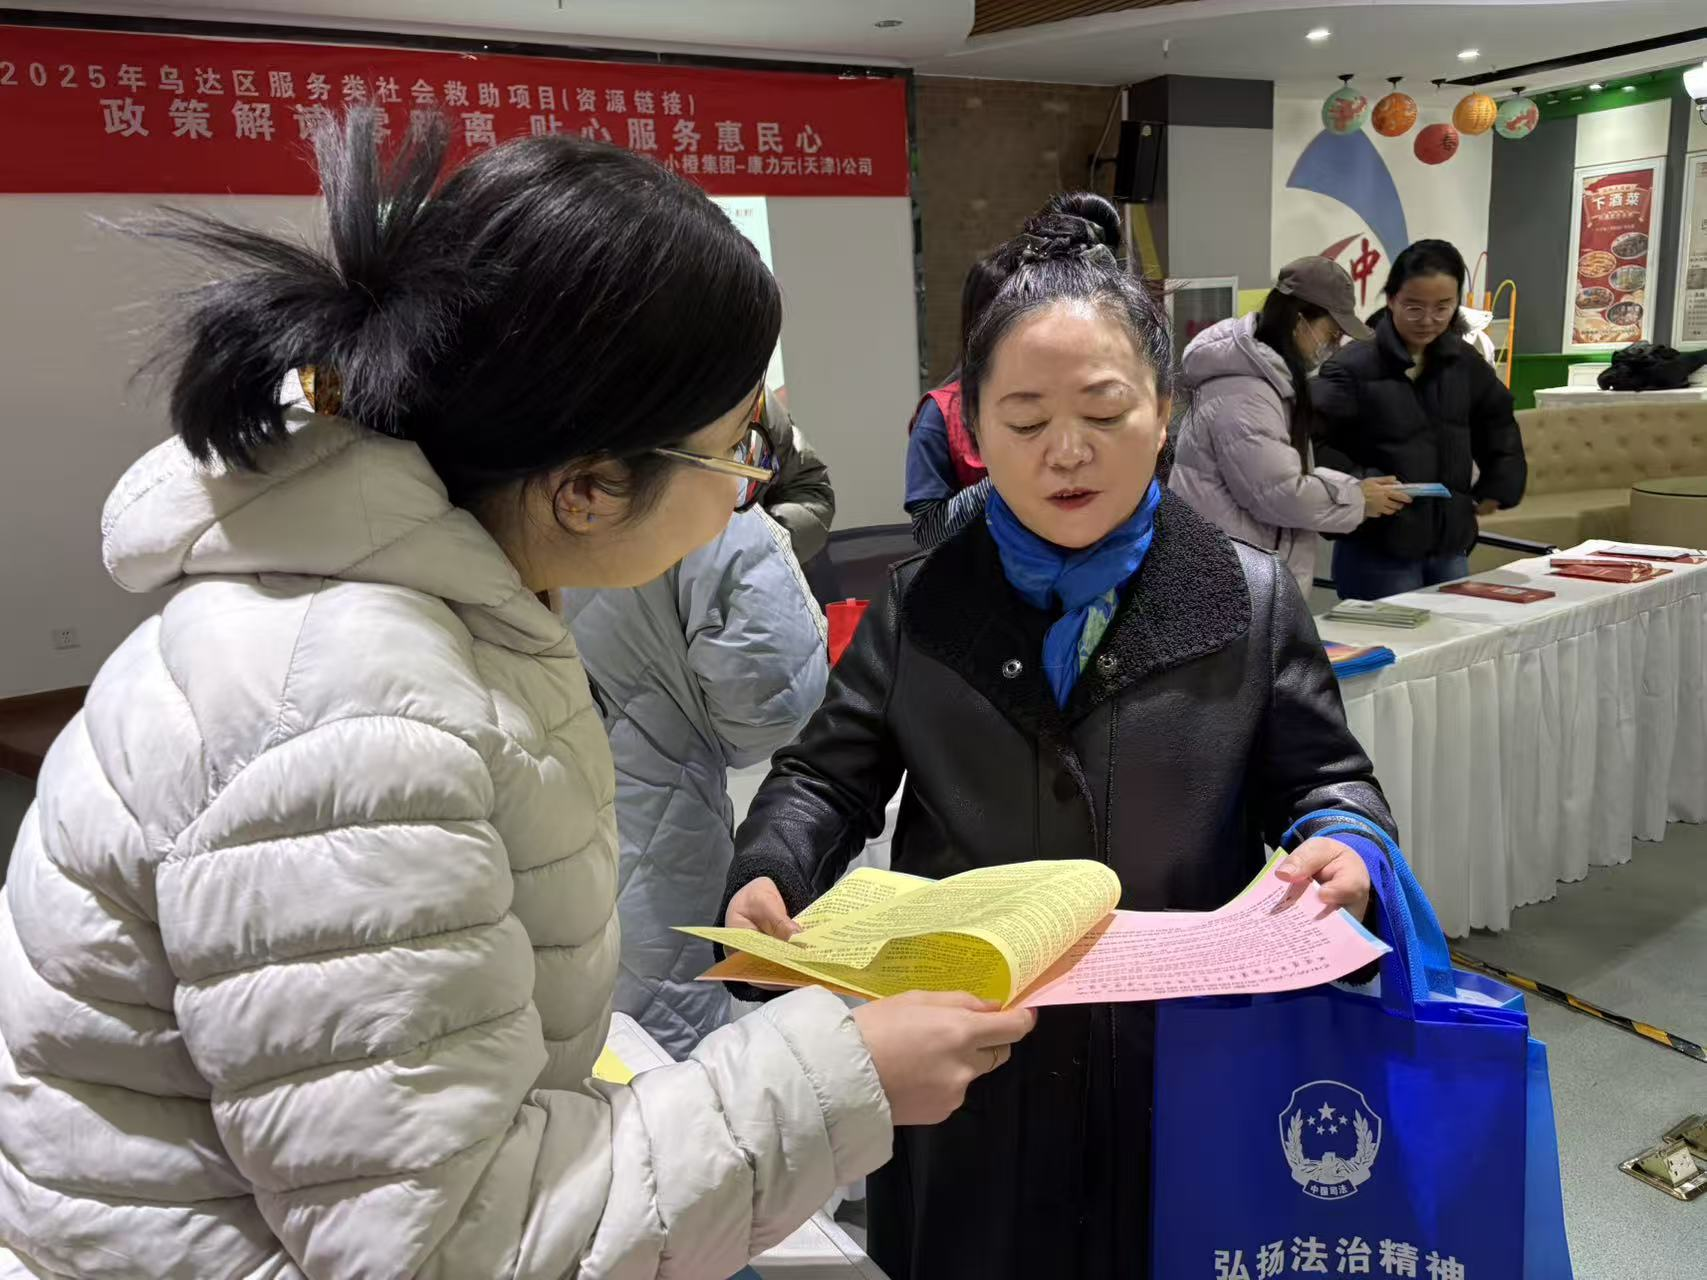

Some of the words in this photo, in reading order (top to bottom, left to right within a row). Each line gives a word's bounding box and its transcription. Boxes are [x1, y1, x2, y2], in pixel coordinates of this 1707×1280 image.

[1350, 238, 1381, 307] 中
[1310, 1184, 1348, 1196] 中国司法
[1214, 1236, 1465, 1280] 弘扬法治精神
